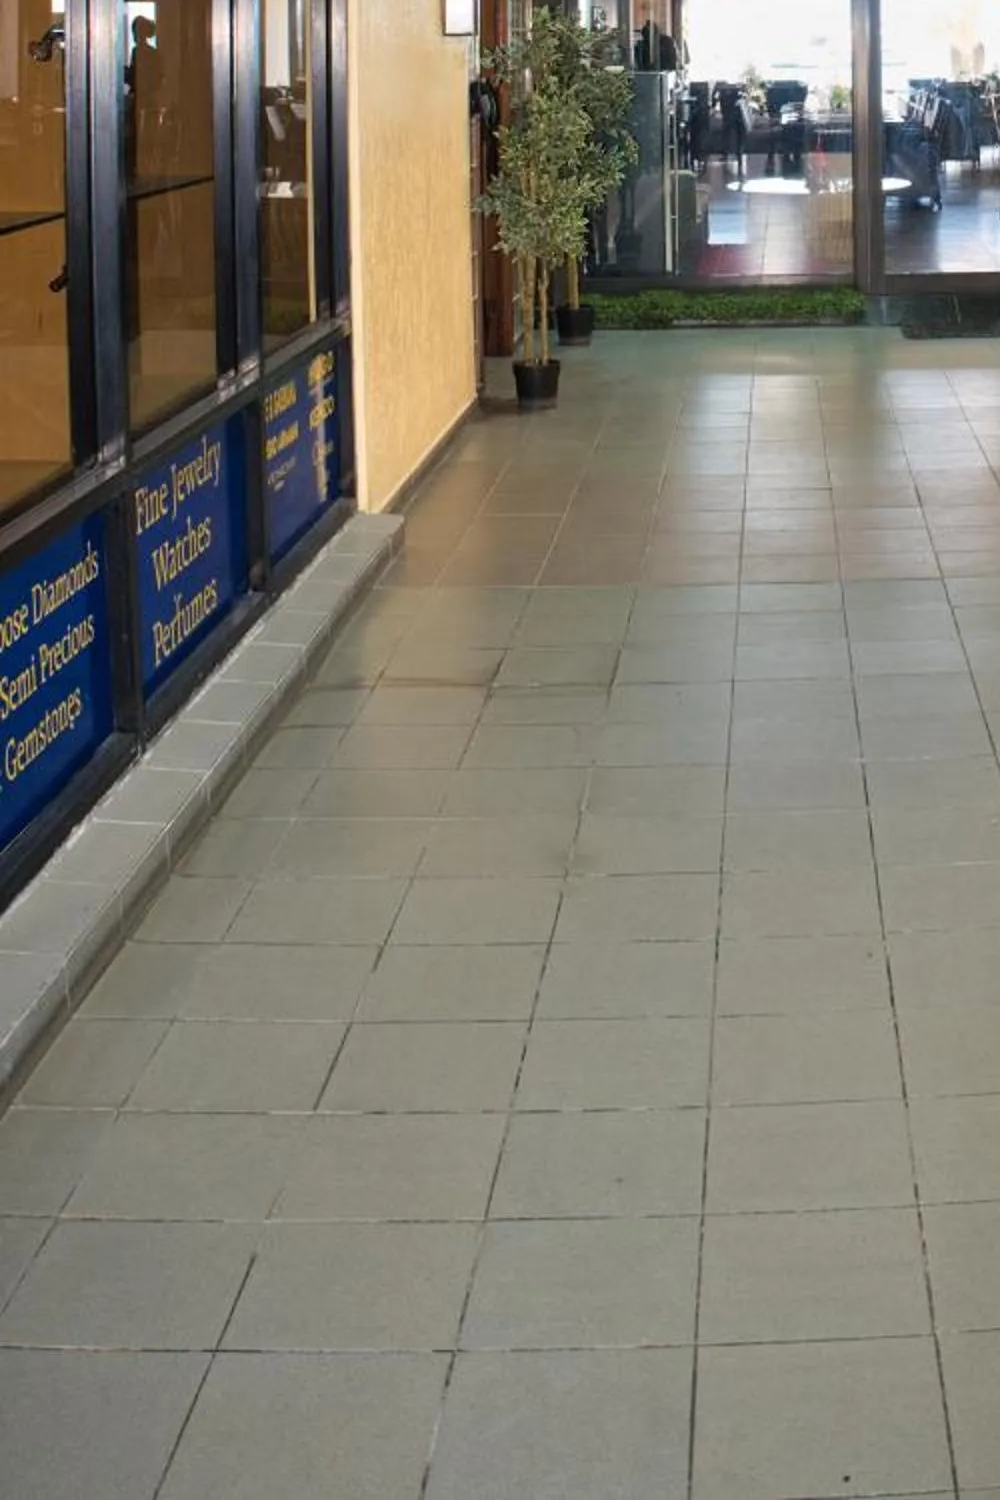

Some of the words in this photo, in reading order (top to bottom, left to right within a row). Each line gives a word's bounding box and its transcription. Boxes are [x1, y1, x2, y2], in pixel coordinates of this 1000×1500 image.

[135, 482, 169, 536] Fine
[170, 434, 221, 521] Jewelry
[31, 540, 99, 626] Diamonds
[152, 515, 212, 591] Watches
[0, 654, 37, 720] Semi
[39, 614, 96, 684] Precious
[152, 579, 218, 668] Perfumes
[5, 687, 82, 782] Gemstones
